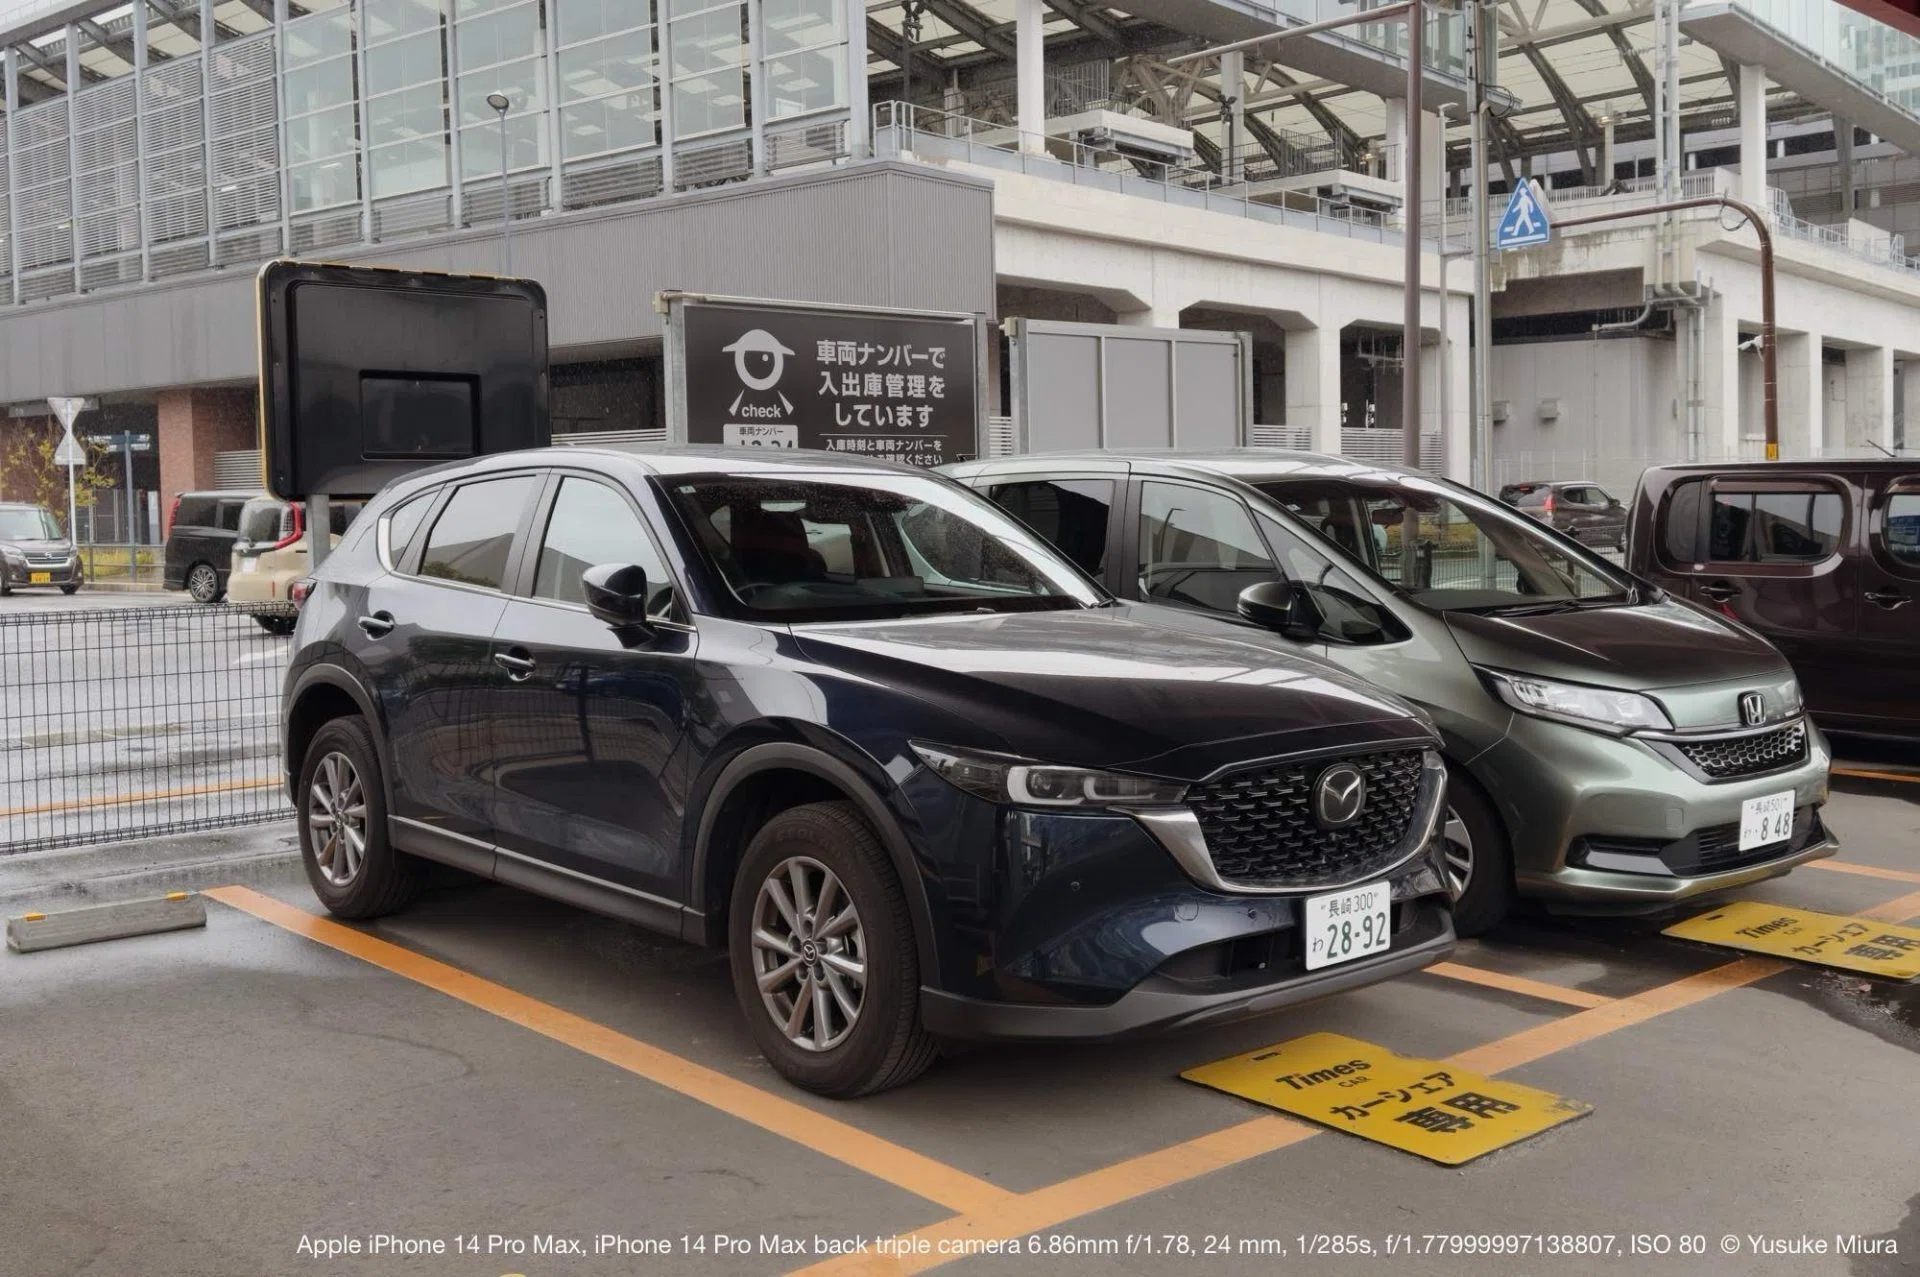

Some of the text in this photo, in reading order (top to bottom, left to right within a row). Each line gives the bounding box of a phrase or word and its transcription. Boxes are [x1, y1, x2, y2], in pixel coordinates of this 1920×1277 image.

[816, 339, 946, 369] 車両ナンバーで
[818, 371, 945, 398] 入出庫管理を
[741, 403, 782, 418] check
[835, 402, 934, 428] しています
[826, 438, 943, 451] 入庫時刻と車両ナンバーを
[1329, 892, 1374, 918] 長崎 300
[1312, 911, 1387, 959] わ 28-92
[1735, 916, 1799, 939] Times
[1275, 1059, 1372, 1090] Times
[1338, 1075, 1374, 1088] CAR
[1329, 1071, 1456, 1121] カーシェア
[1393, 1091, 1522, 1133] 専用
